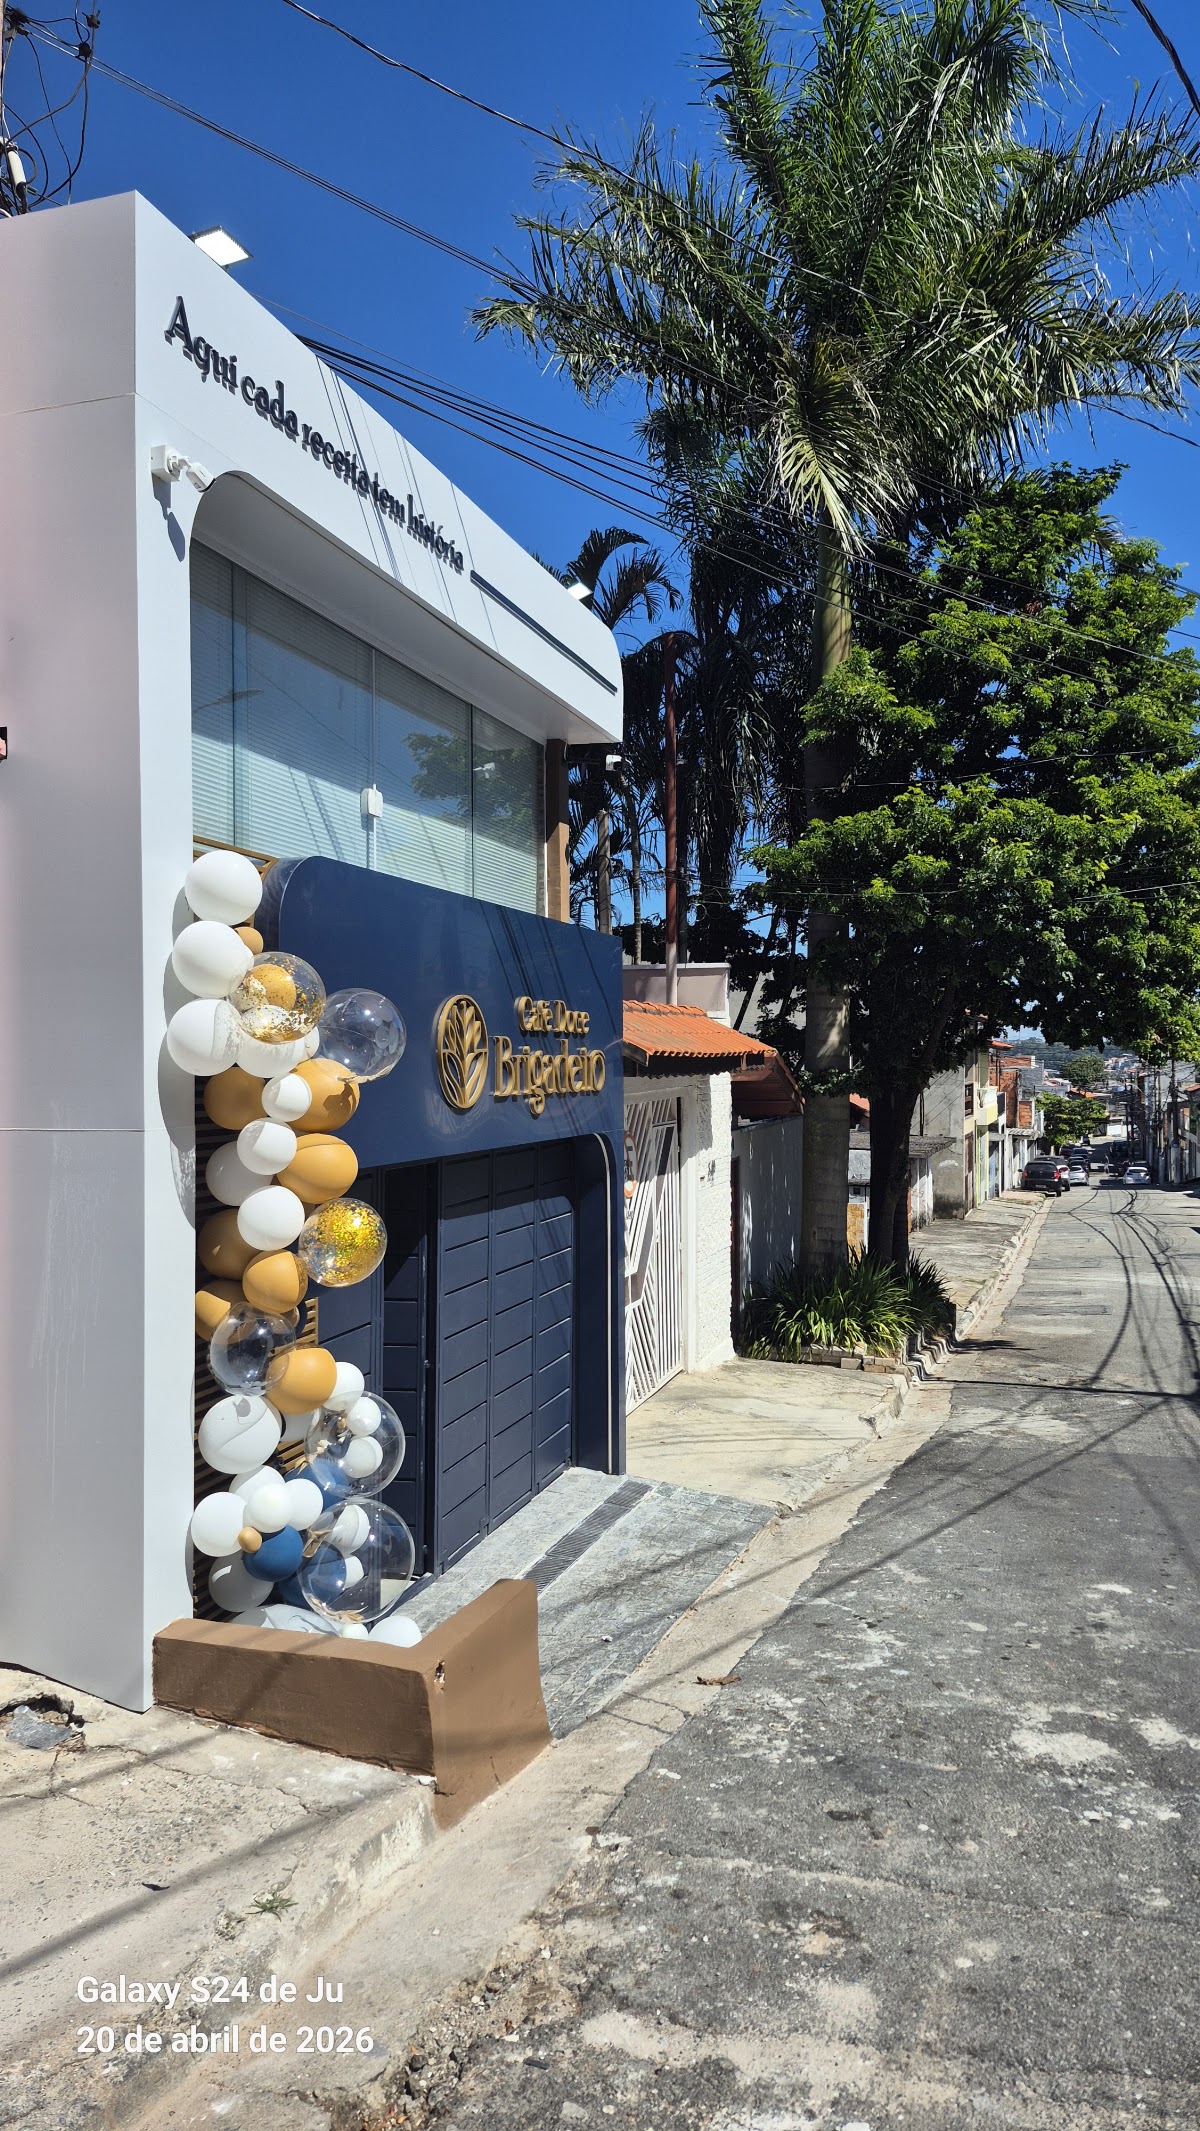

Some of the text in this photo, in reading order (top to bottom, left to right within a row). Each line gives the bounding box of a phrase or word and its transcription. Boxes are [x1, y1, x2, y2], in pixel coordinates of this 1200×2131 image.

[164, 295, 464, 573] Aqui cada receita tem história
[553, 1000, 590, 1033] Doce
